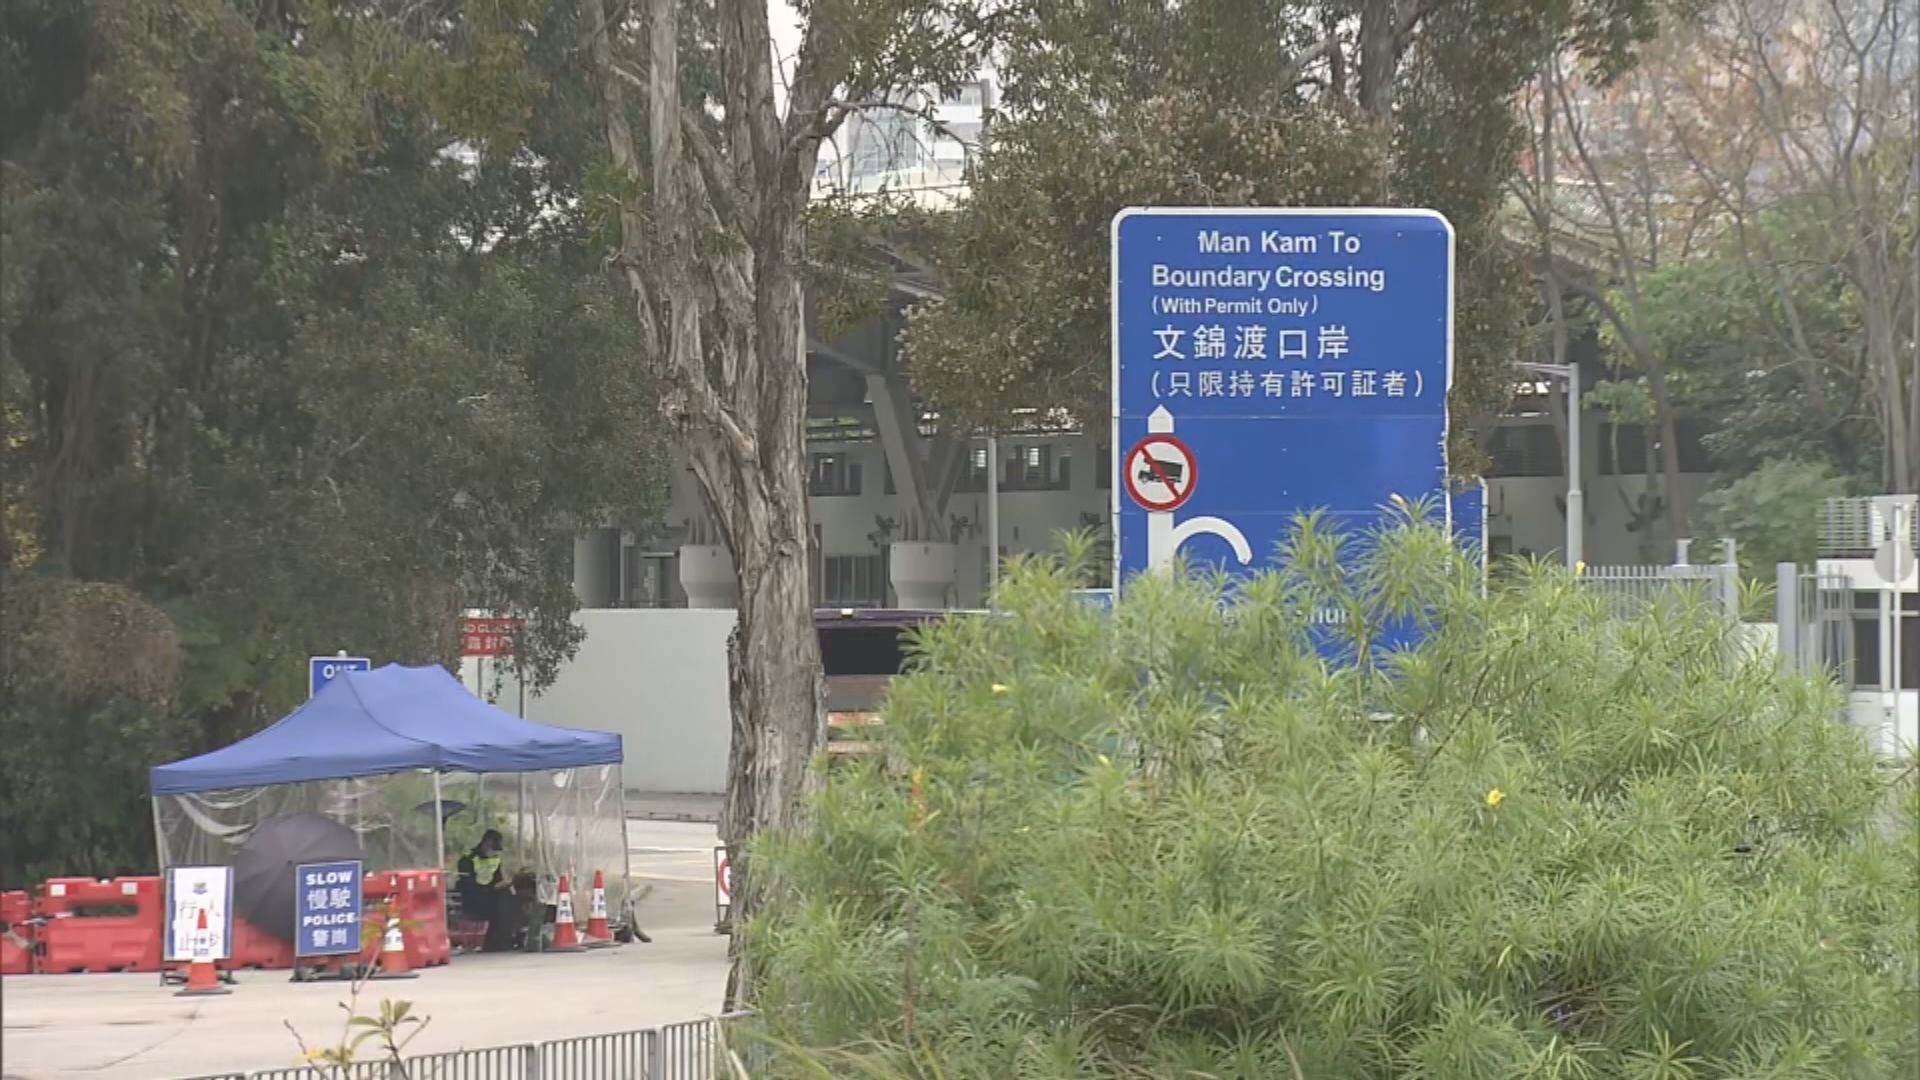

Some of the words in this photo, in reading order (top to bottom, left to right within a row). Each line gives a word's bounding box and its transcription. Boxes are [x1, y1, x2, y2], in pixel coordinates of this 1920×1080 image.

[1198, 230, 1251, 254] Man
[1261, 230, 1317, 254] Kam
[1328, 230, 1361, 254] To
[1152, 264, 1271, 291] Boundary
[1275, 264, 1386, 292] Crossing
[1151, 294, 1202, 315] (With
[1204, 296, 1263, 315] Permit
[1267, 294, 1318, 317] Only)
[1152, 324, 1350, 360] 文錦渡口岸
[305, 870, 353, 886] SLOW
[303, 911, 356, 927] POLICE
